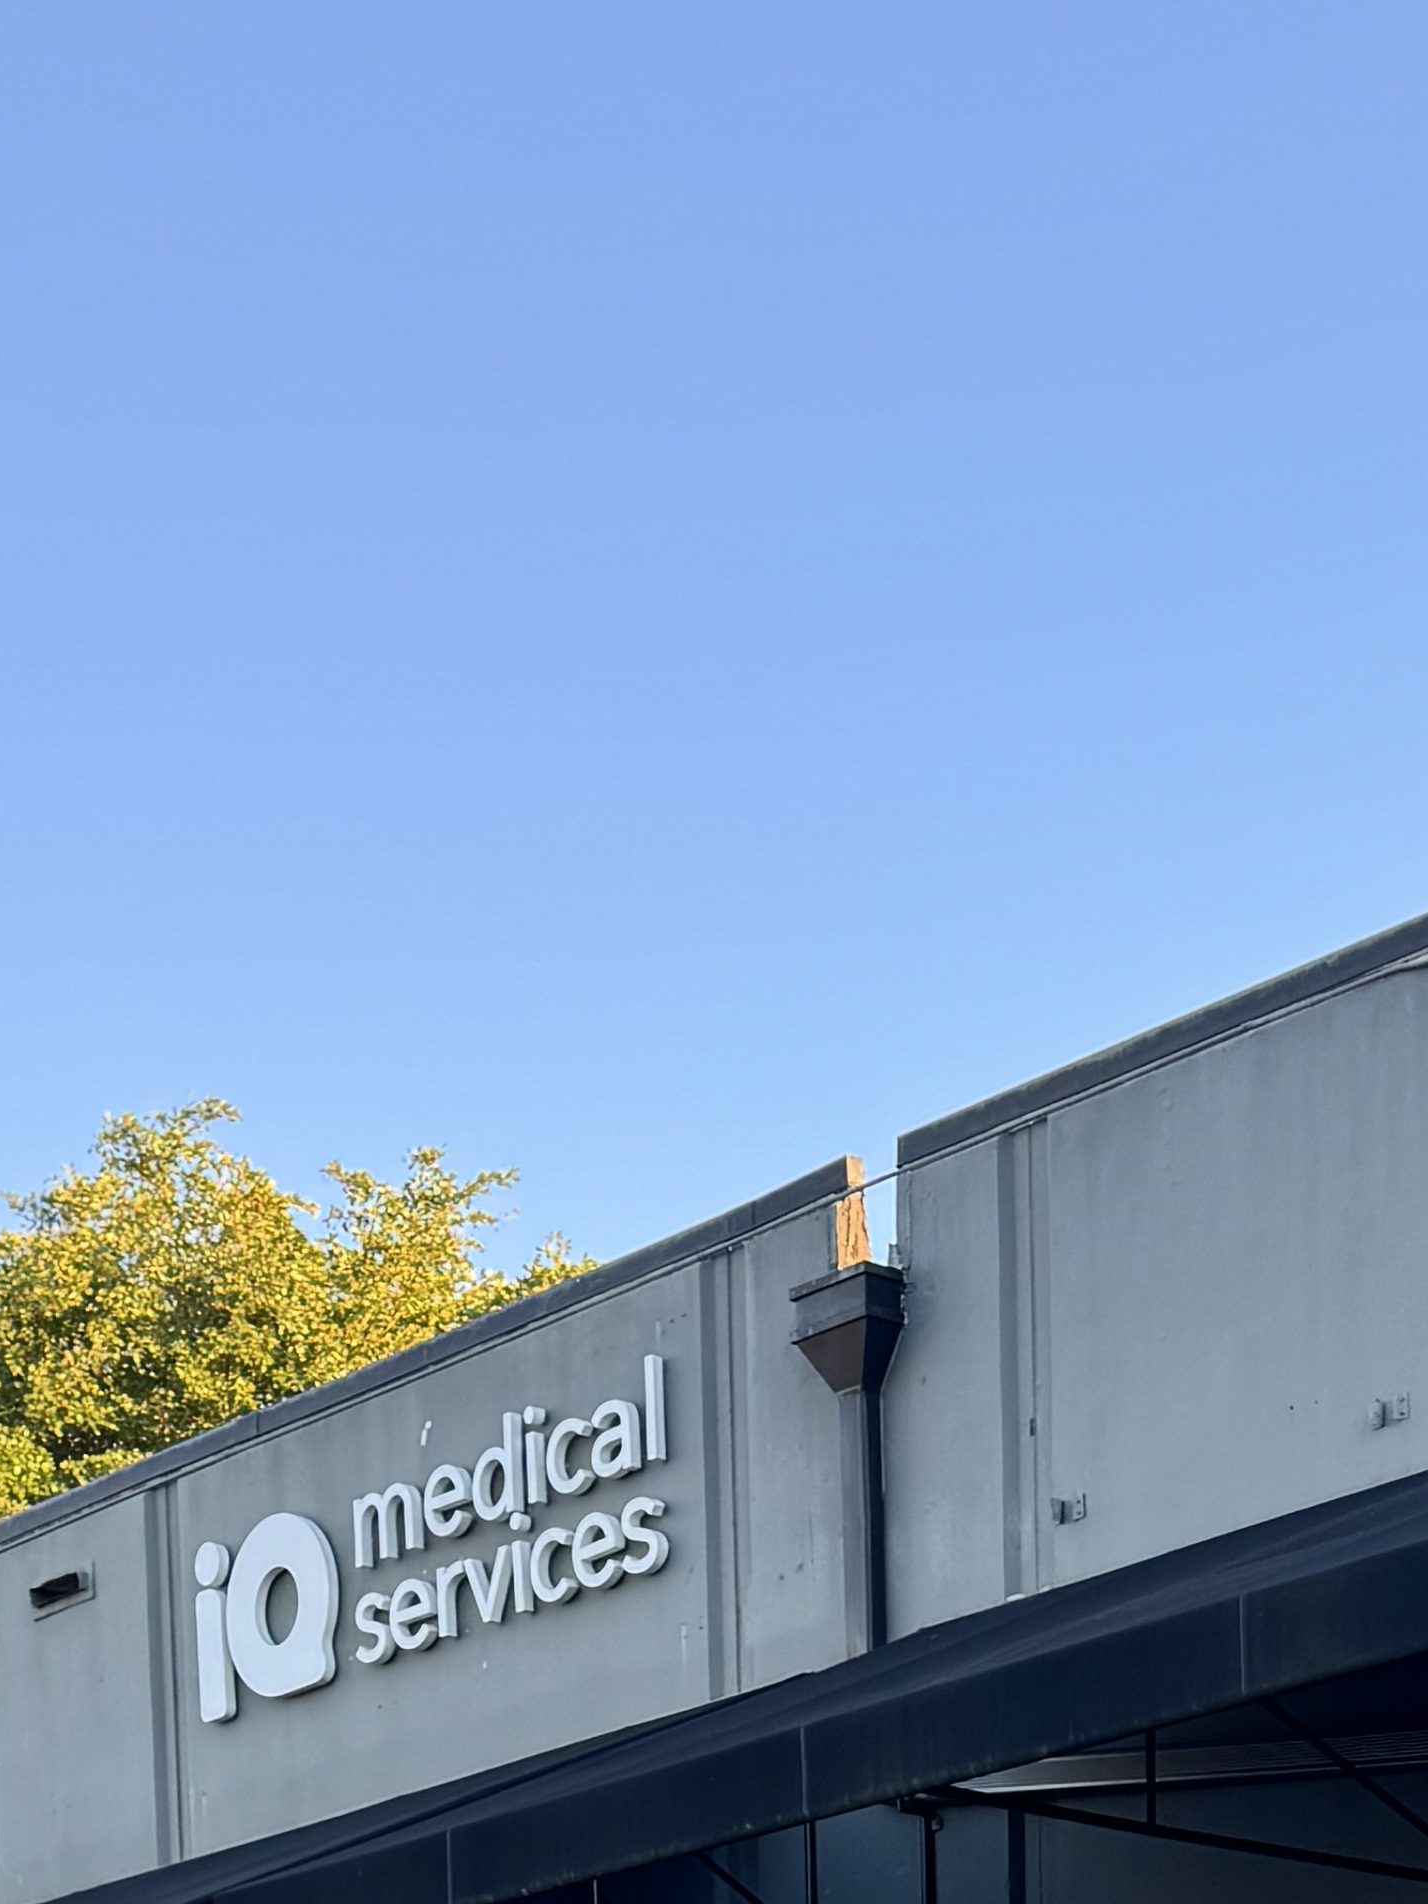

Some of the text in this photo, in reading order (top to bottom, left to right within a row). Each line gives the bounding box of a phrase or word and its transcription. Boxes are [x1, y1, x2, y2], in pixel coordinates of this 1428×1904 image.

[353, 1354, 667, 1568] medical
[194, 1512, 340, 1724] iQ
[355, 1496, 670, 1665] services
